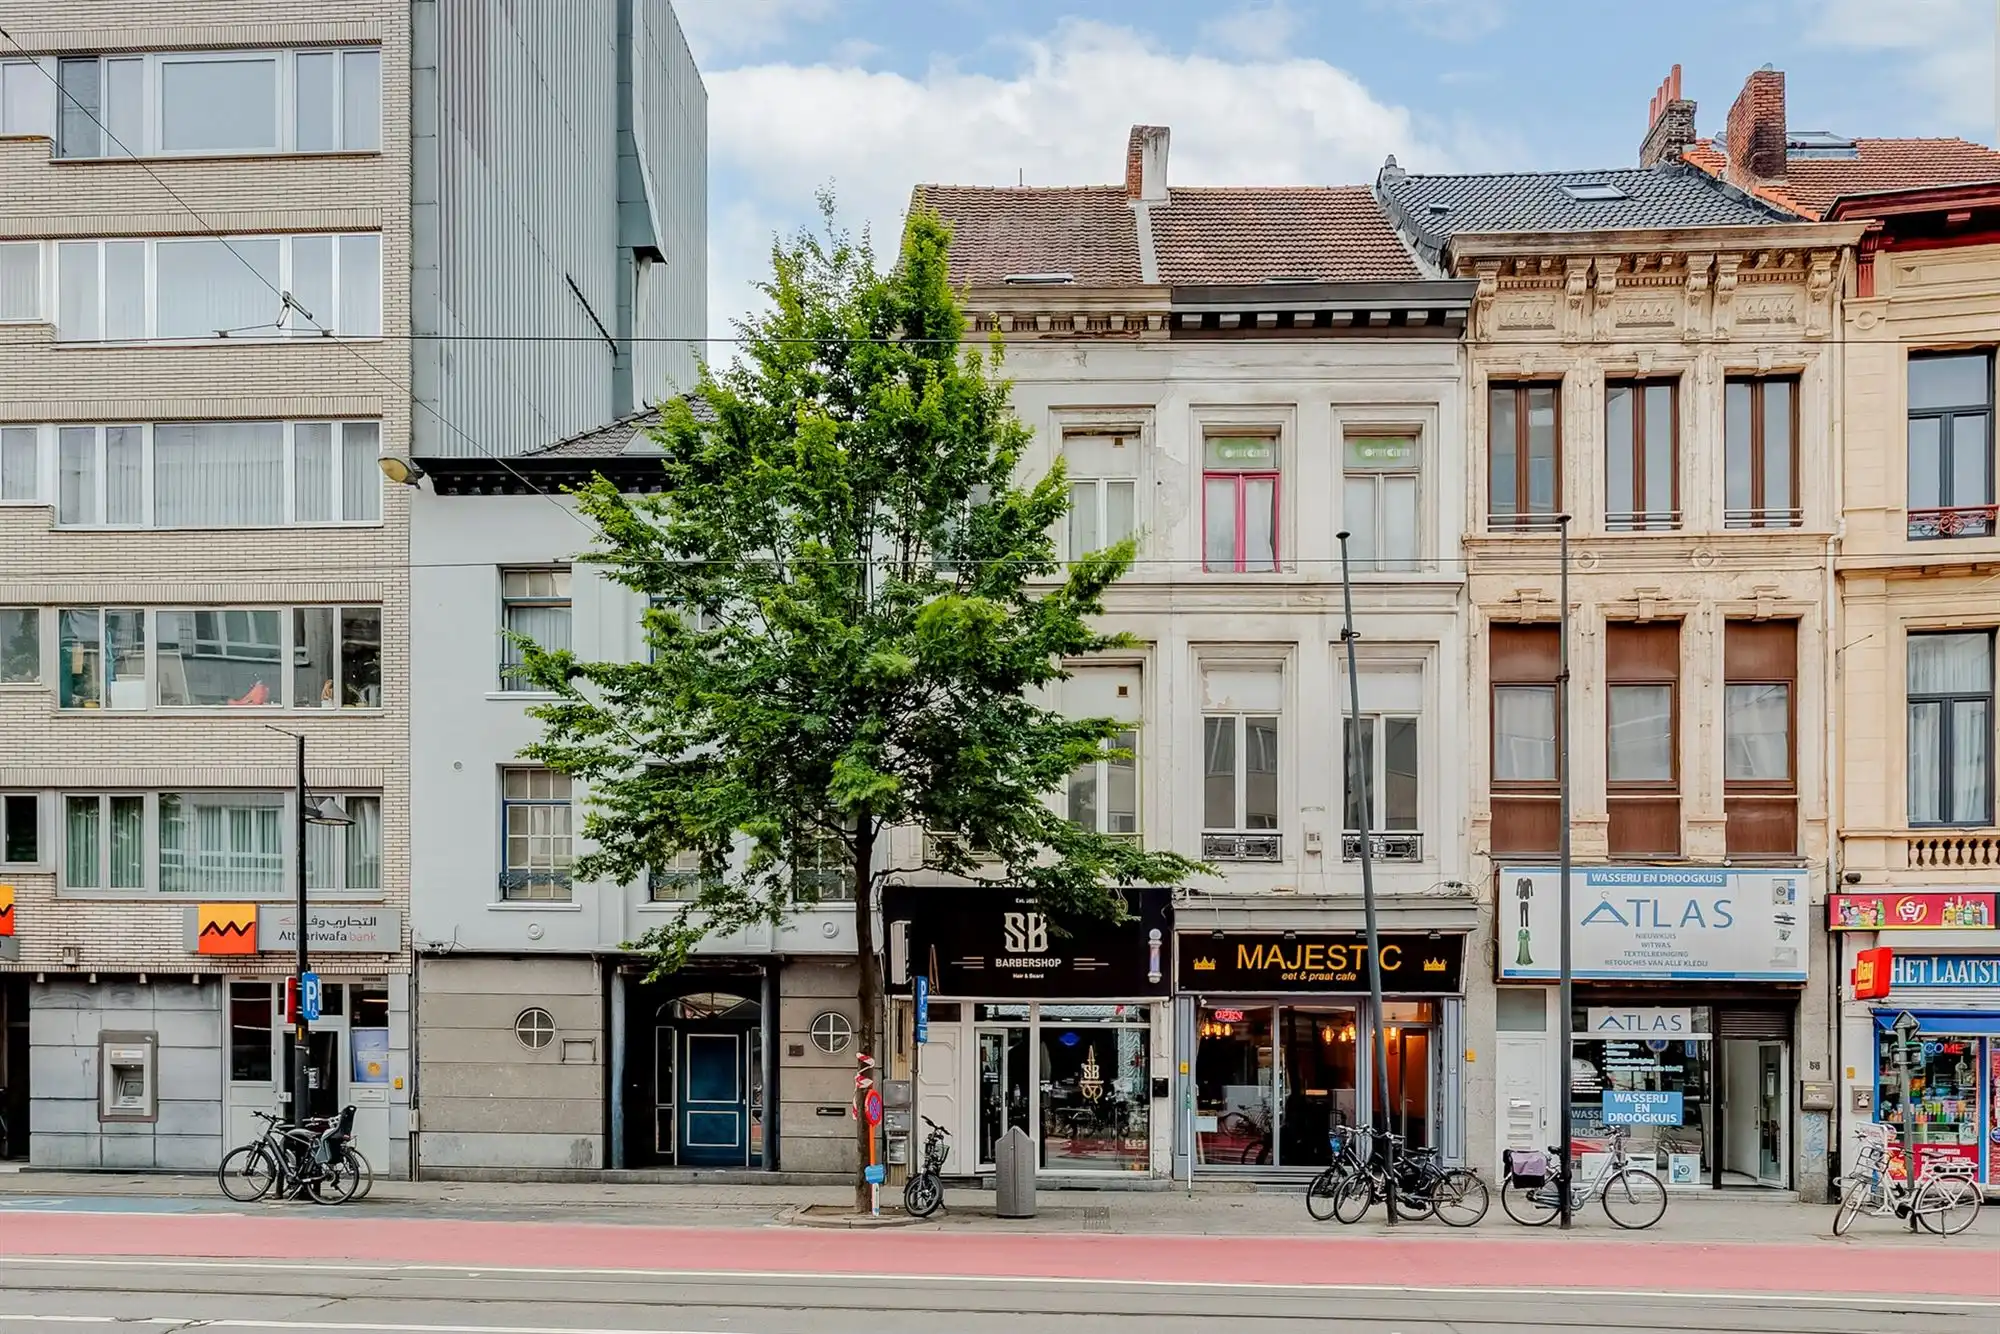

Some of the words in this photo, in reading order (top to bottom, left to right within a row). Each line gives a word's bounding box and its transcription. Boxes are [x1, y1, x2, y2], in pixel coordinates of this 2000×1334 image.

[1591, 873, 1641, 883] WASSERIJ
[1643, 874, 1658, 883] EN
[1659, 874, 1724, 884] DROOGKUIS
[1580, 896, 1734, 928] ATLAS
[349, 931, 377, 941] bank
[1003, 912, 1049, 952] SB
[995, 958, 1062, 968] BARBERSHOP
[1236, 944, 1402, 971] MAJESTC
[1604, 958, 1647, 967] RETOUCHES
[1648, 959, 1664, 967] VAN
[1664, 959, 1682, 967] ALLE
[1890, 957, 1929, 984] HET
[1281, 971, 1298, 981] eet
[1299, 971, 1307, 981] &
[1308, 971, 1334, 982] praat
[306, 980, 317, 1011] P
[1214, 1010, 1244, 1021] OPEN
[1598, 1012, 1682, 1031] ATLAS
[1613, 1093, 1669, 1104] WASSERIJ
[1634, 1103, 1650, 1113] EN
[1607, 1113, 1678, 1123] DROOGKUIS
